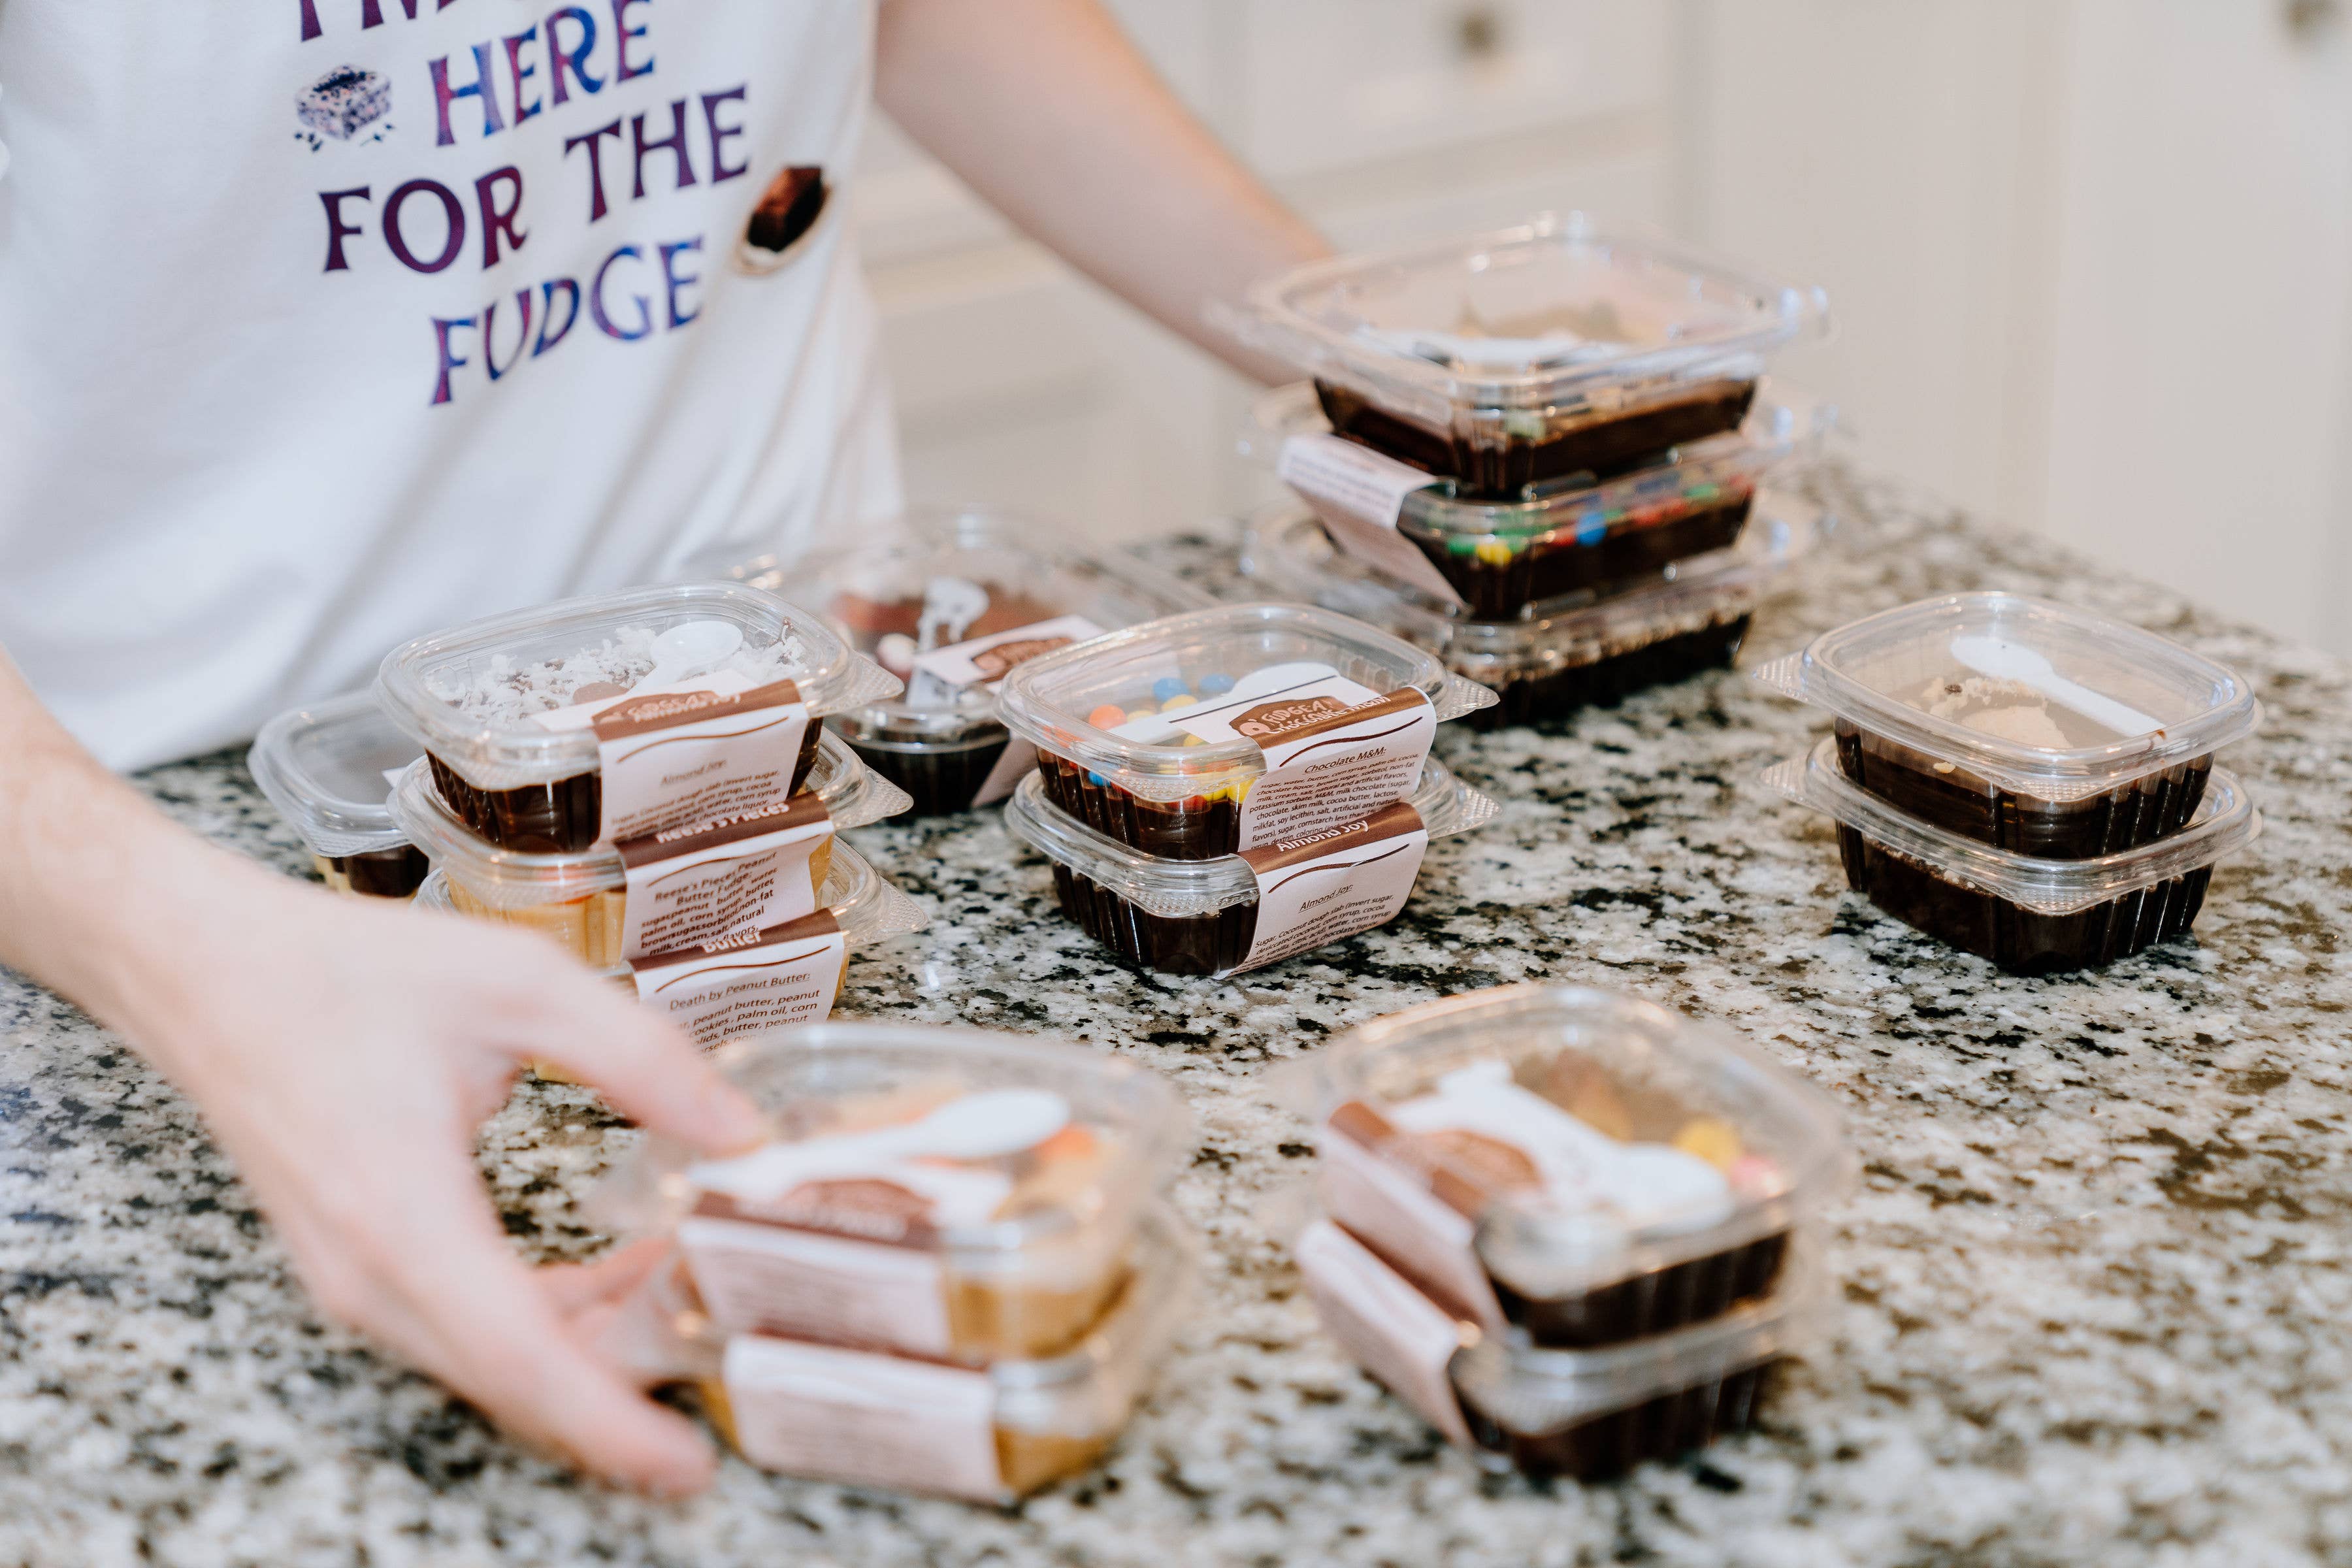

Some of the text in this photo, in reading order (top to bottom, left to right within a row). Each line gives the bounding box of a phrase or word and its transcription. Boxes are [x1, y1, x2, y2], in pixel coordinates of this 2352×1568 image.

[427, 0, 655, 147] HERE
[317, 84, 748, 274] FOR THE
[429, 235, 707, 406] FUDGE
[1304, 747, 1386, 774] Chocolate M&M:
[746, 781, 772, 791] cocoa
[1256, 787, 1291, 796] chocolate
[1389, 761, 1415, 770] non-fat
[1315, 783, 1339, 793] natural
[1354, 774, 1383, 785] artificial
[735, 793, 755, 802] corn
[757, 787, 781, 798] syrup
[1249, 800, 1284, 814] potassium
[1335, 787, 1350, 796] milk
[1352, 783, 1386, 793] chocolate
[1387, 779, 1411, 789] (sugar,
[1292, 802, 1307, 812] skim
[1326, 796, 1348, 805] cocoa
[1373, 789, 1399, 798] lactose
[1277, 816, 1288, 825] soy
[1332, 803, 1361, 813] artificial
[1278, 825, 1296, 836] sugar,
[1298, 816, 1333, 829] cornstarch
[1334, 813, 1348, 822] less
[1276, 828, 1342, 852] Almond
[1340, 819, 1369, 834] Joy
[677, 890, 714, 906] Butter
[1299, 889, 1337, 912] Almond
[1363, 904, 1385, 913] cocoa
[640, 925, 667, 941] palm
[690, 911, 713, 923] corn
[1279, 922, 1307, 938] Coconut
[1307, 911, 1330, 926] dough
[1345, 898, 1371, 910] (invert
[1371, 894, 1394, 904] sugar,
[1371, 910, 1392, 920] syrup
[1320, 926, 1355, 941] chocolate
[670, 973, 811, 1011] Death by Peanut Butter:
[693, 1005, 732, 1028] peanut
[734, 998, 775, 1010] butter,
[777, 989, 821, 1005] peanut
[737, 1009, 768, 1022] palm
[770, 1005, 788, 1016] oil,
[791, 1002, 818, 1013] corn
[693, 1015, 808, 1047] olids, butter, peanut
